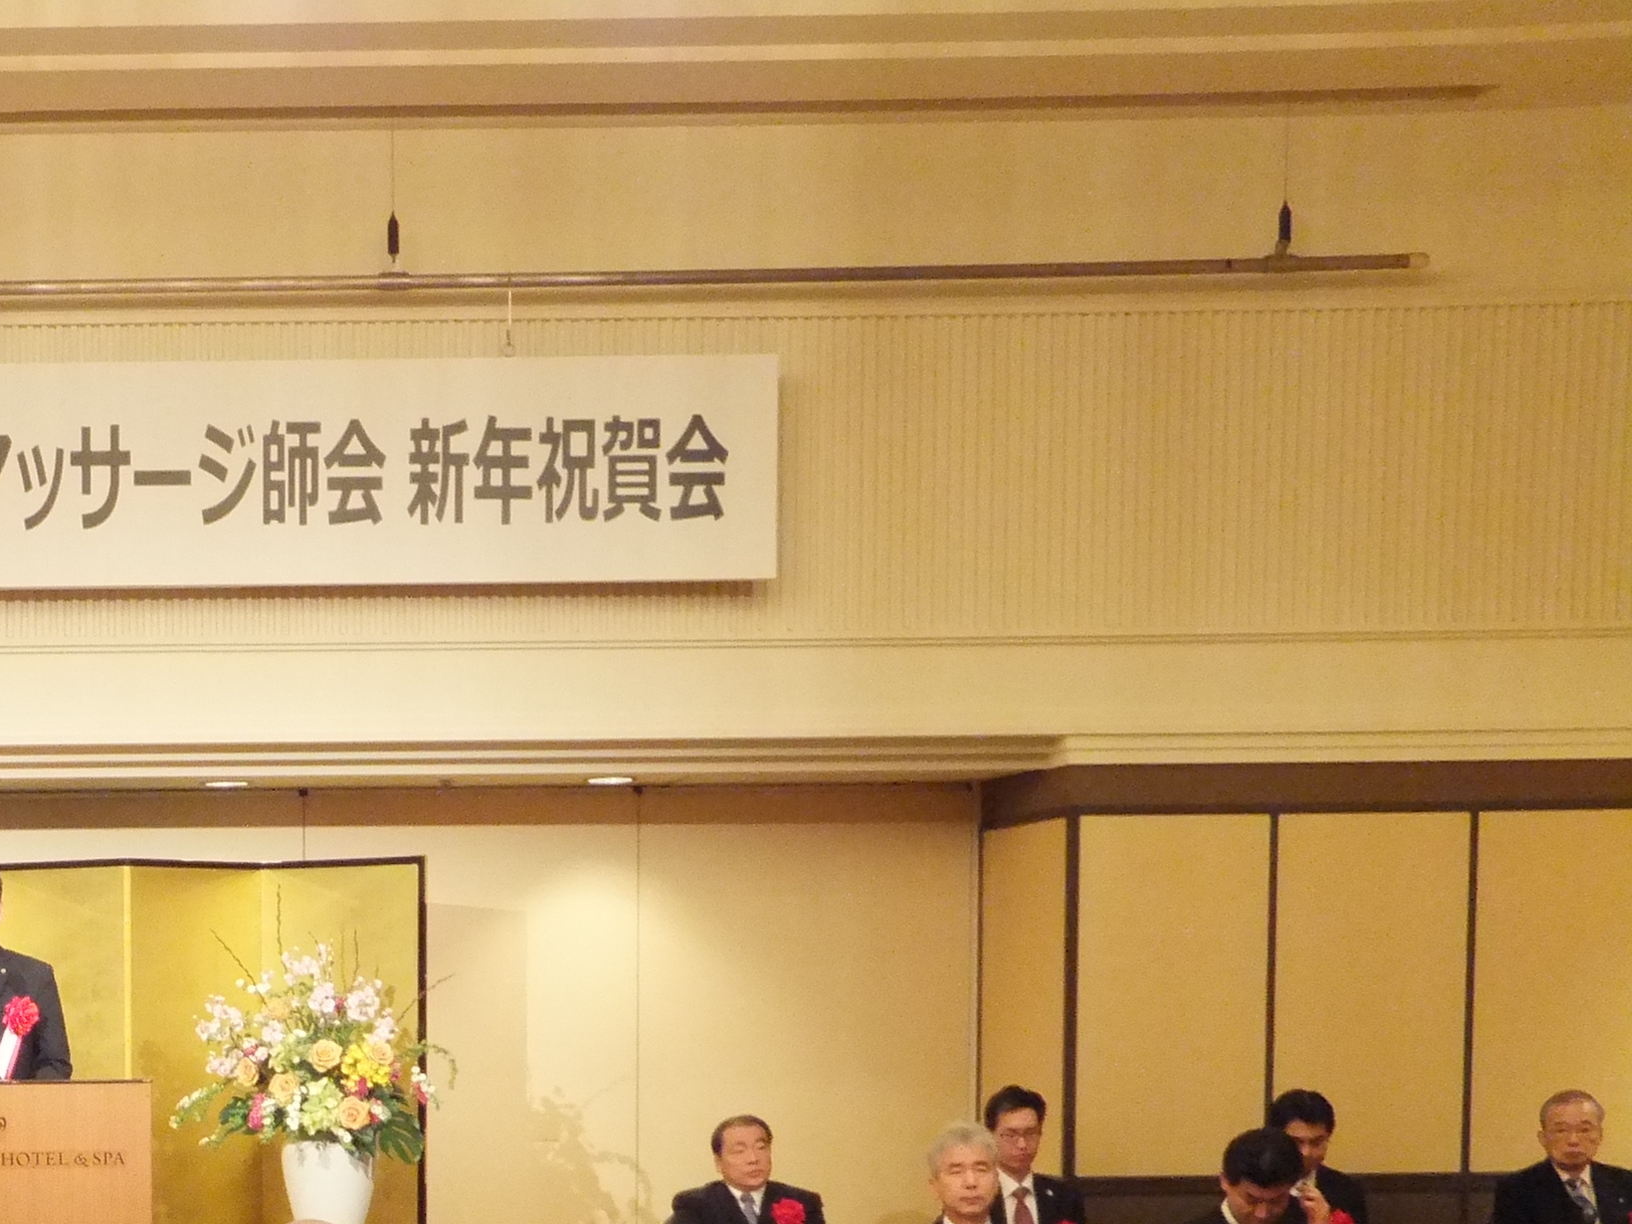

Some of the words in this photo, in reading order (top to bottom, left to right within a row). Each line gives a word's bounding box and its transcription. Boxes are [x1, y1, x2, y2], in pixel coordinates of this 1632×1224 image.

[407, 414, 729, 525] 新年祝賀会
[0, 1151, 68, 1168] HOTEL
[73, 1154, 89, 1168] &
[91, 1150, 126, 1167] SPA
